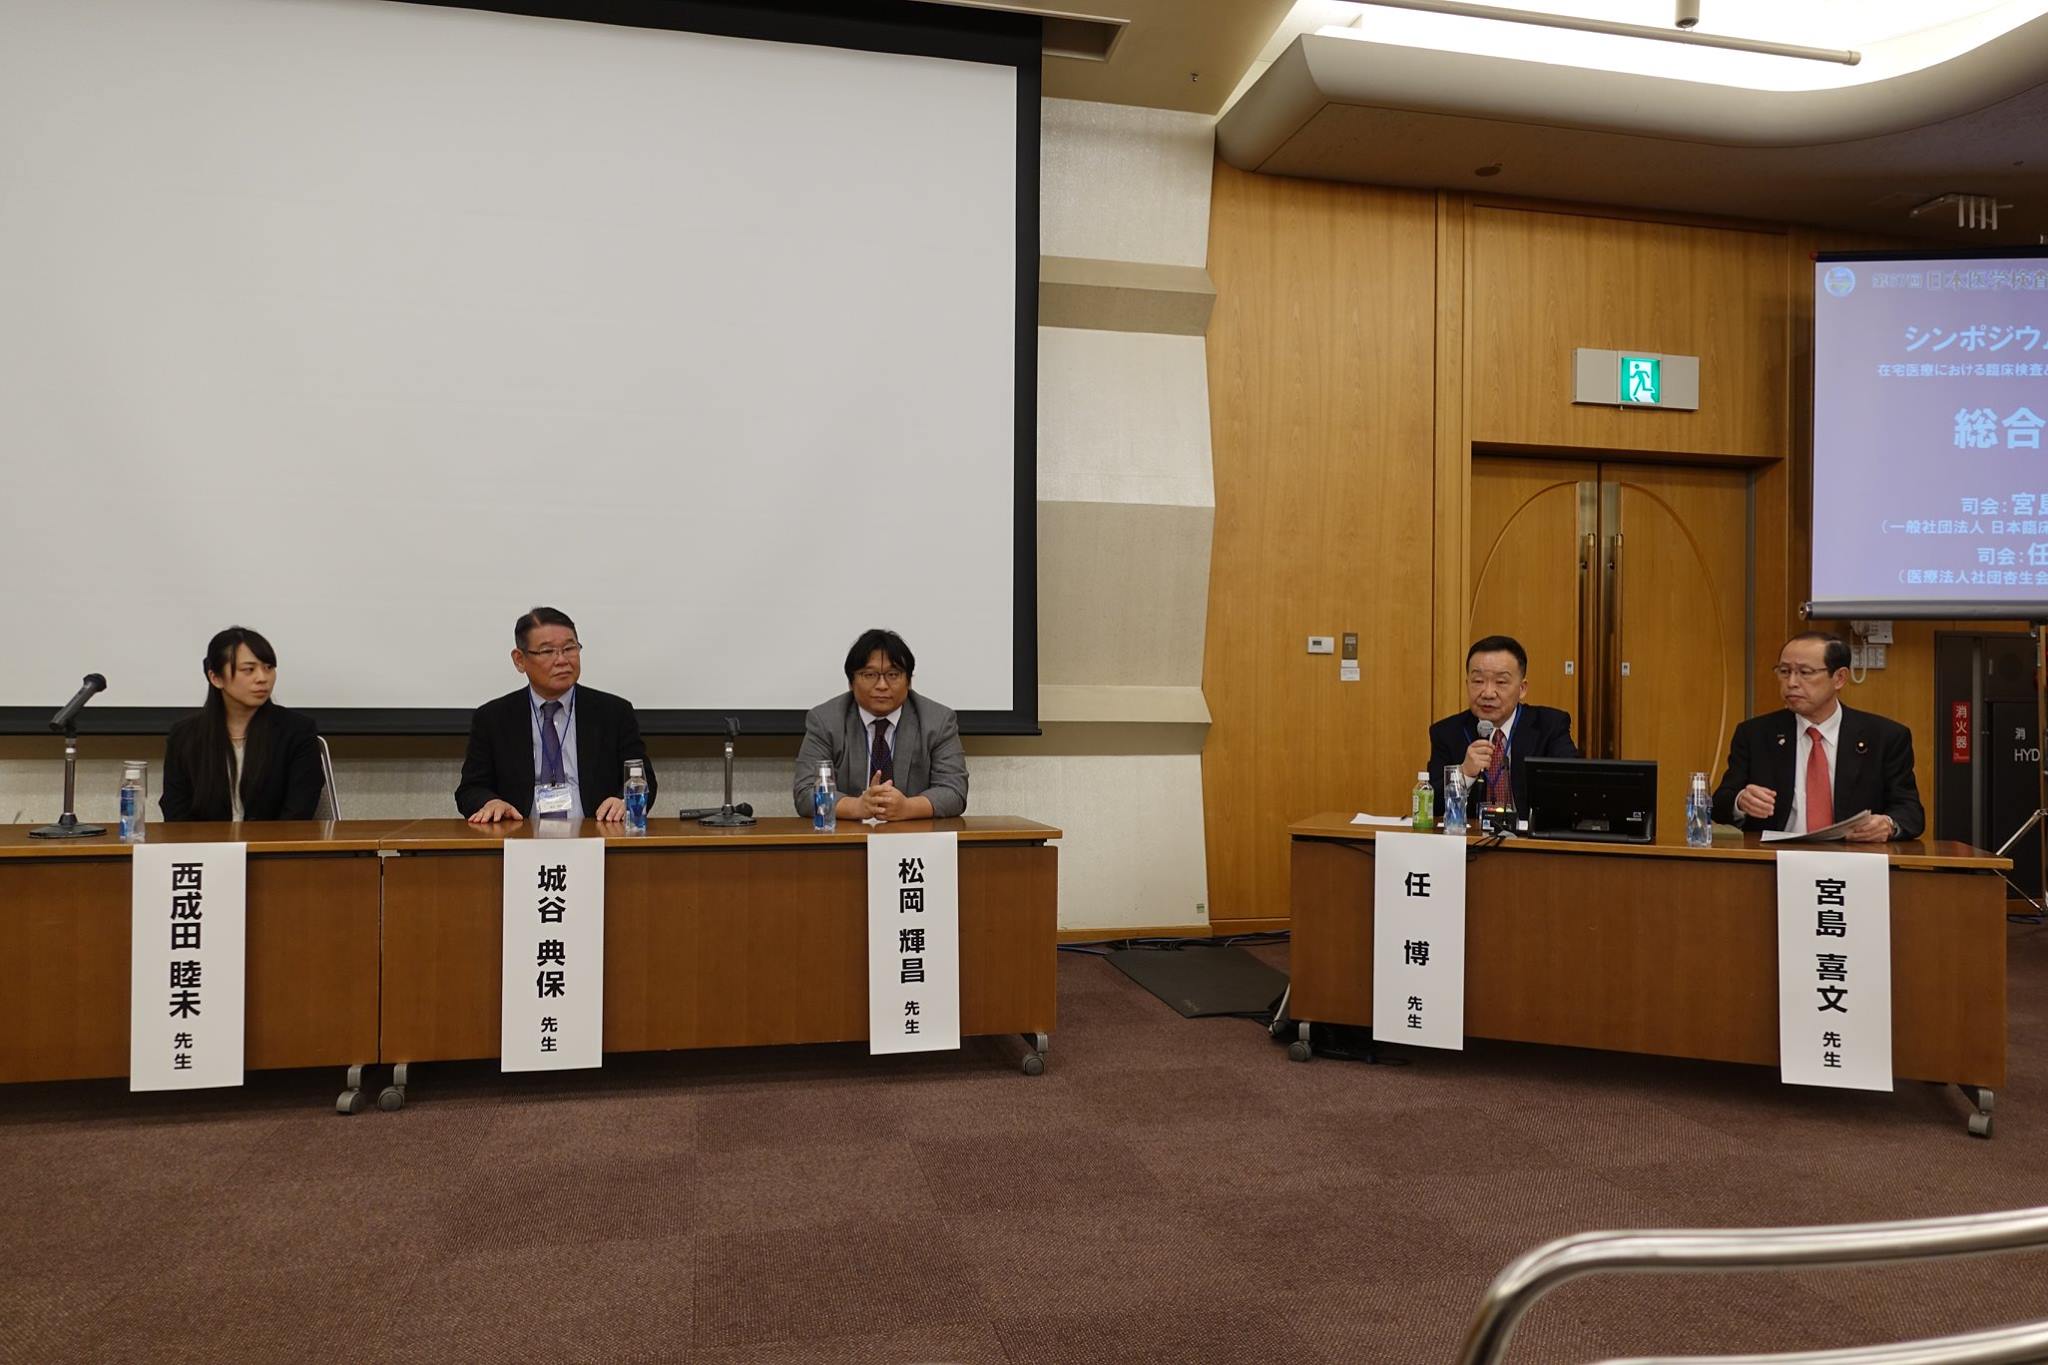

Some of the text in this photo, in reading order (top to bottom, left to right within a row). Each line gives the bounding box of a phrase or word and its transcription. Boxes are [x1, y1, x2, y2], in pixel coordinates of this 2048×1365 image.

[1904, 324, 2048, 351] シンポジウ
[1954, 407, 2046, 449] 総合
[1956, 704, 1967, 749] 消火器
[170, 862, 203, 1070] 西成田 睦未 先生
[536, 865, 567, 1053] 城谷 典保 先生
[899, 858, 926, 1035] 松岡 輝昌 先生
[1404, 871, 1431, 1030] 任 博 先生
[1815, 879, 1849, 1068] 宮島 喜文 先生
